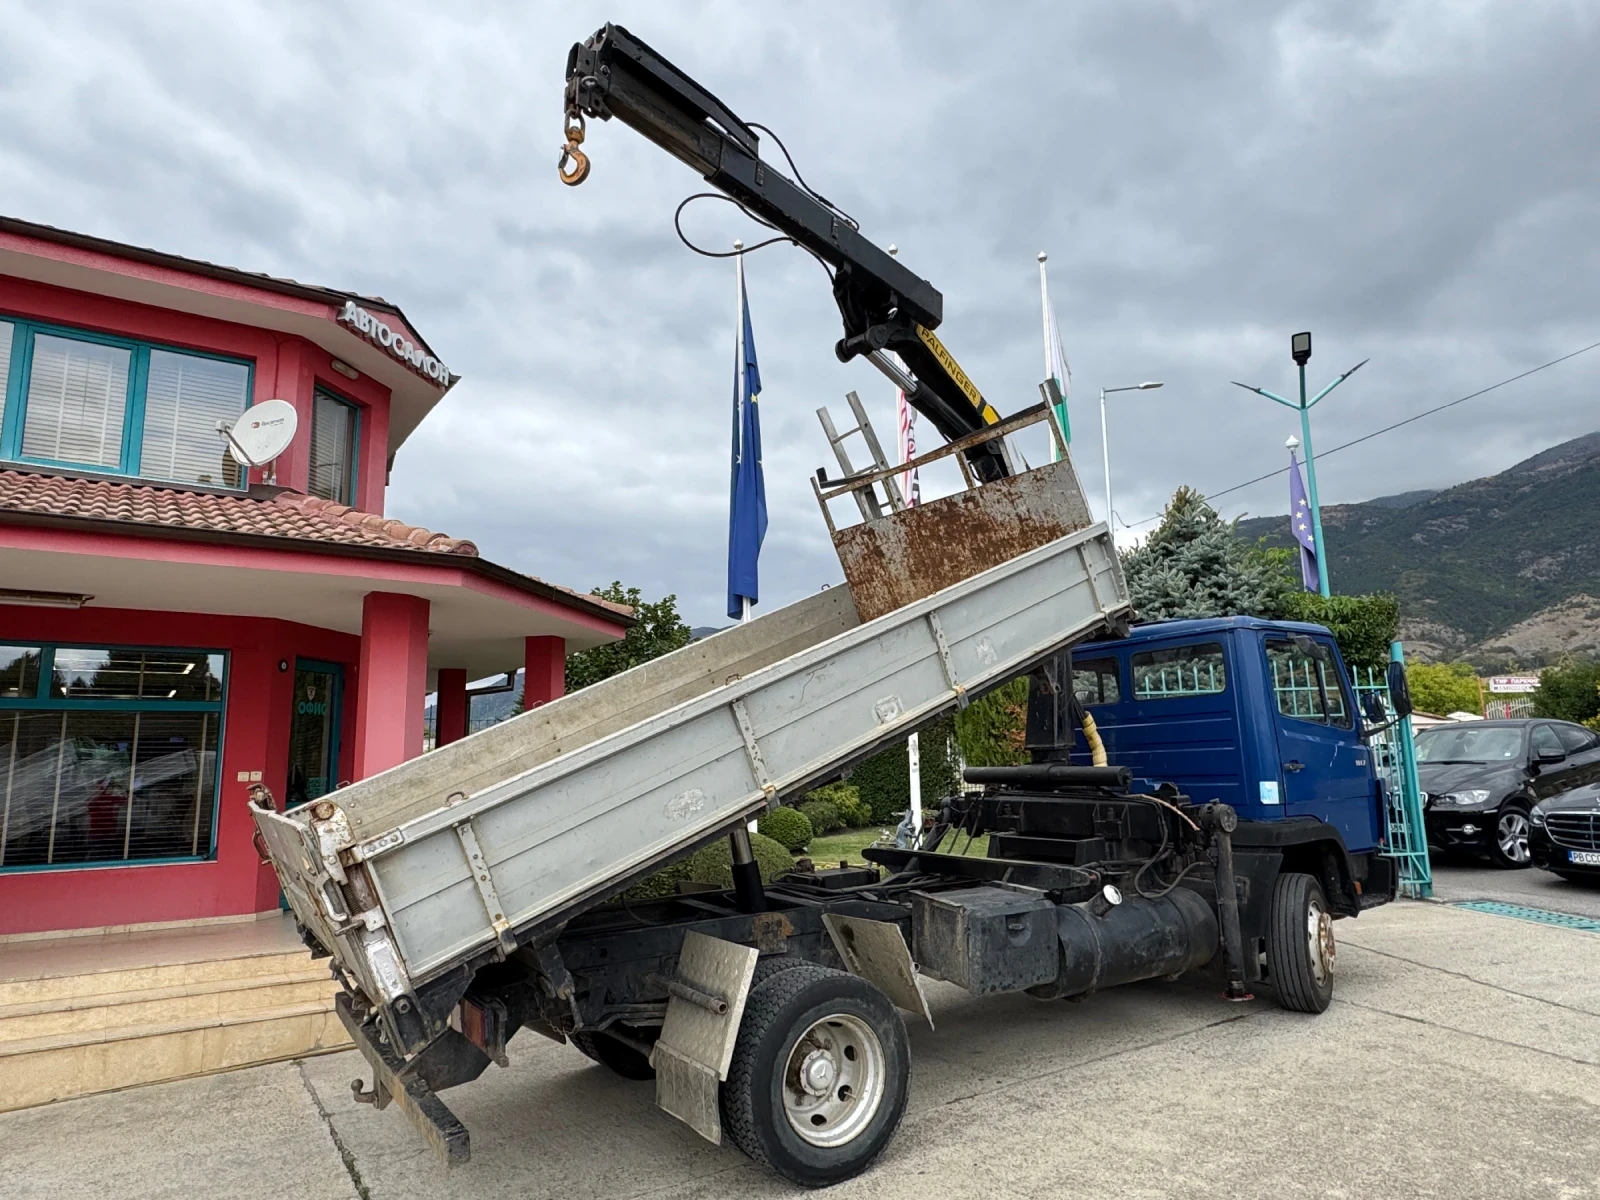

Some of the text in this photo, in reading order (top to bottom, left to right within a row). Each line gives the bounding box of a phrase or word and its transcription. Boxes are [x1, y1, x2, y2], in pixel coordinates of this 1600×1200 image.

[337, 301, 449, 386] АВТОСАЛОН
[921, 327, 977, 401] PALFINGER
[298, 701, 328, 716] ОФИС
